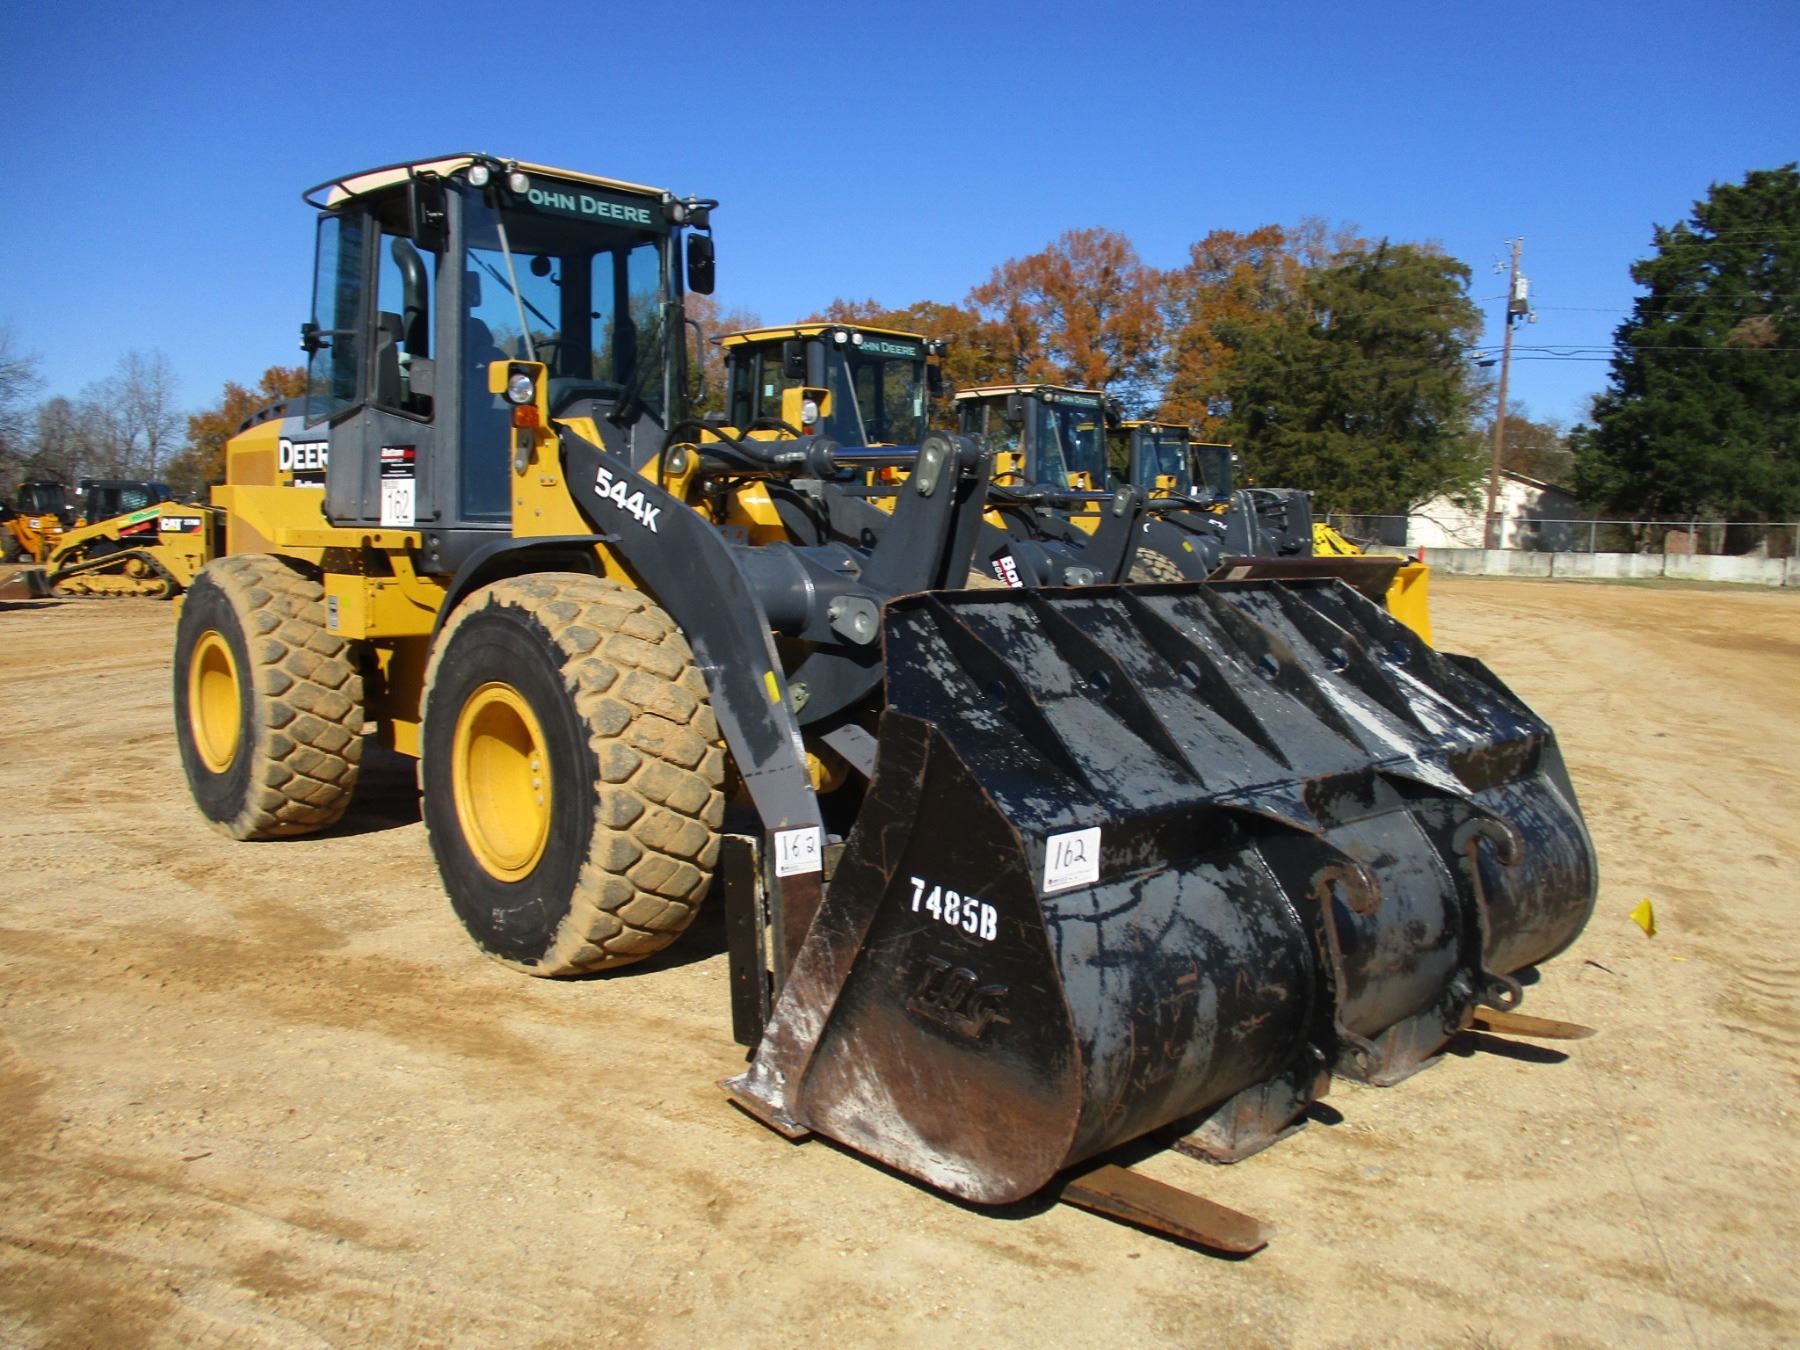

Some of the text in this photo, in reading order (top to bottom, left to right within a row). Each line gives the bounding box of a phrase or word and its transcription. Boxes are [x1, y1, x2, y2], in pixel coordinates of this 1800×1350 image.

[527, 188, 652, 224] OHN DEERE
[880, 341, 917, 356] DEERE
[278, 439, 329, 471] DEER
[594, 466, 661, 534] 544K
[783, 833, 816, 861] 162
[1054, 838, 1088, 870] 162
[910, 876, 998, 941] 7485B
